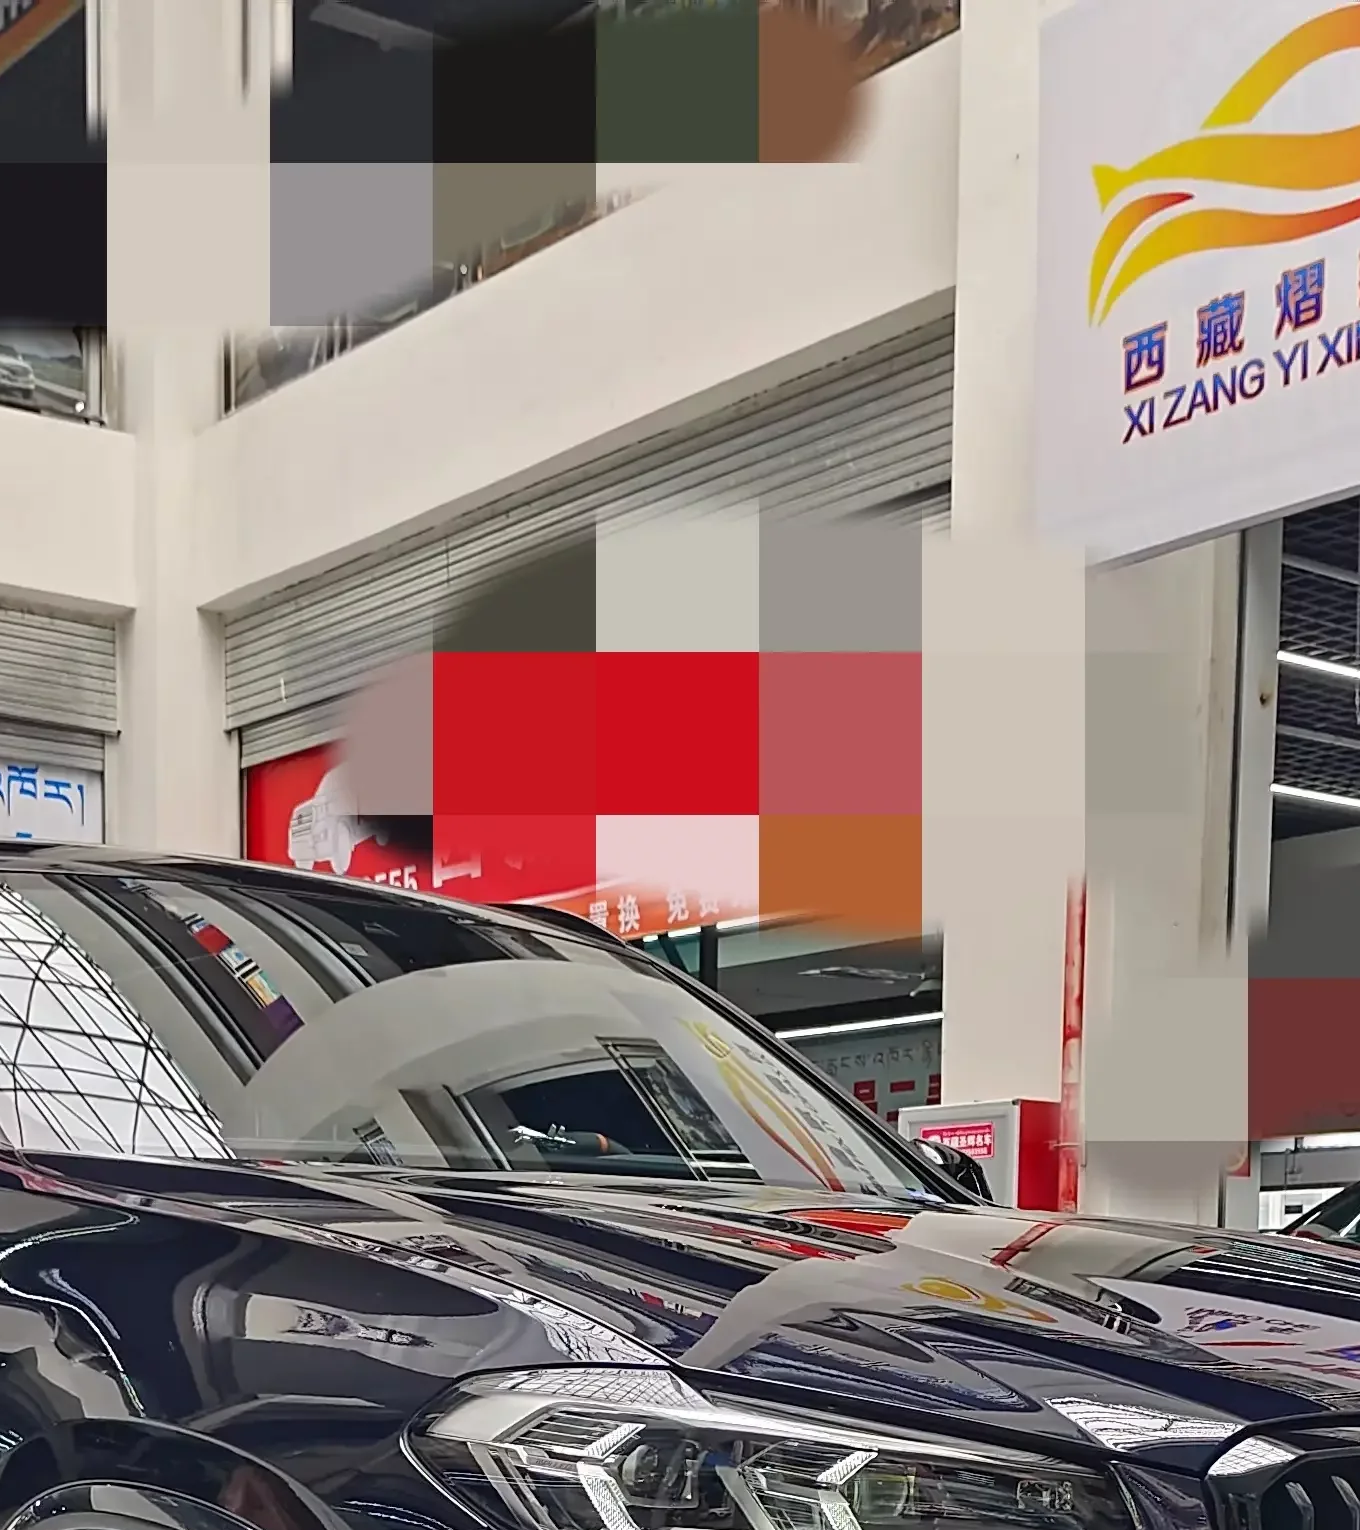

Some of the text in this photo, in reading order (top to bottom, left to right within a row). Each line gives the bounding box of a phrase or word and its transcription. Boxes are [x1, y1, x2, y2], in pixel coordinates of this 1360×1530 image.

[1122, 396, 1155, 444] XI
[1162, 358, 1265, 430] ZANG
[1273, 344, 1309, 388] YI
